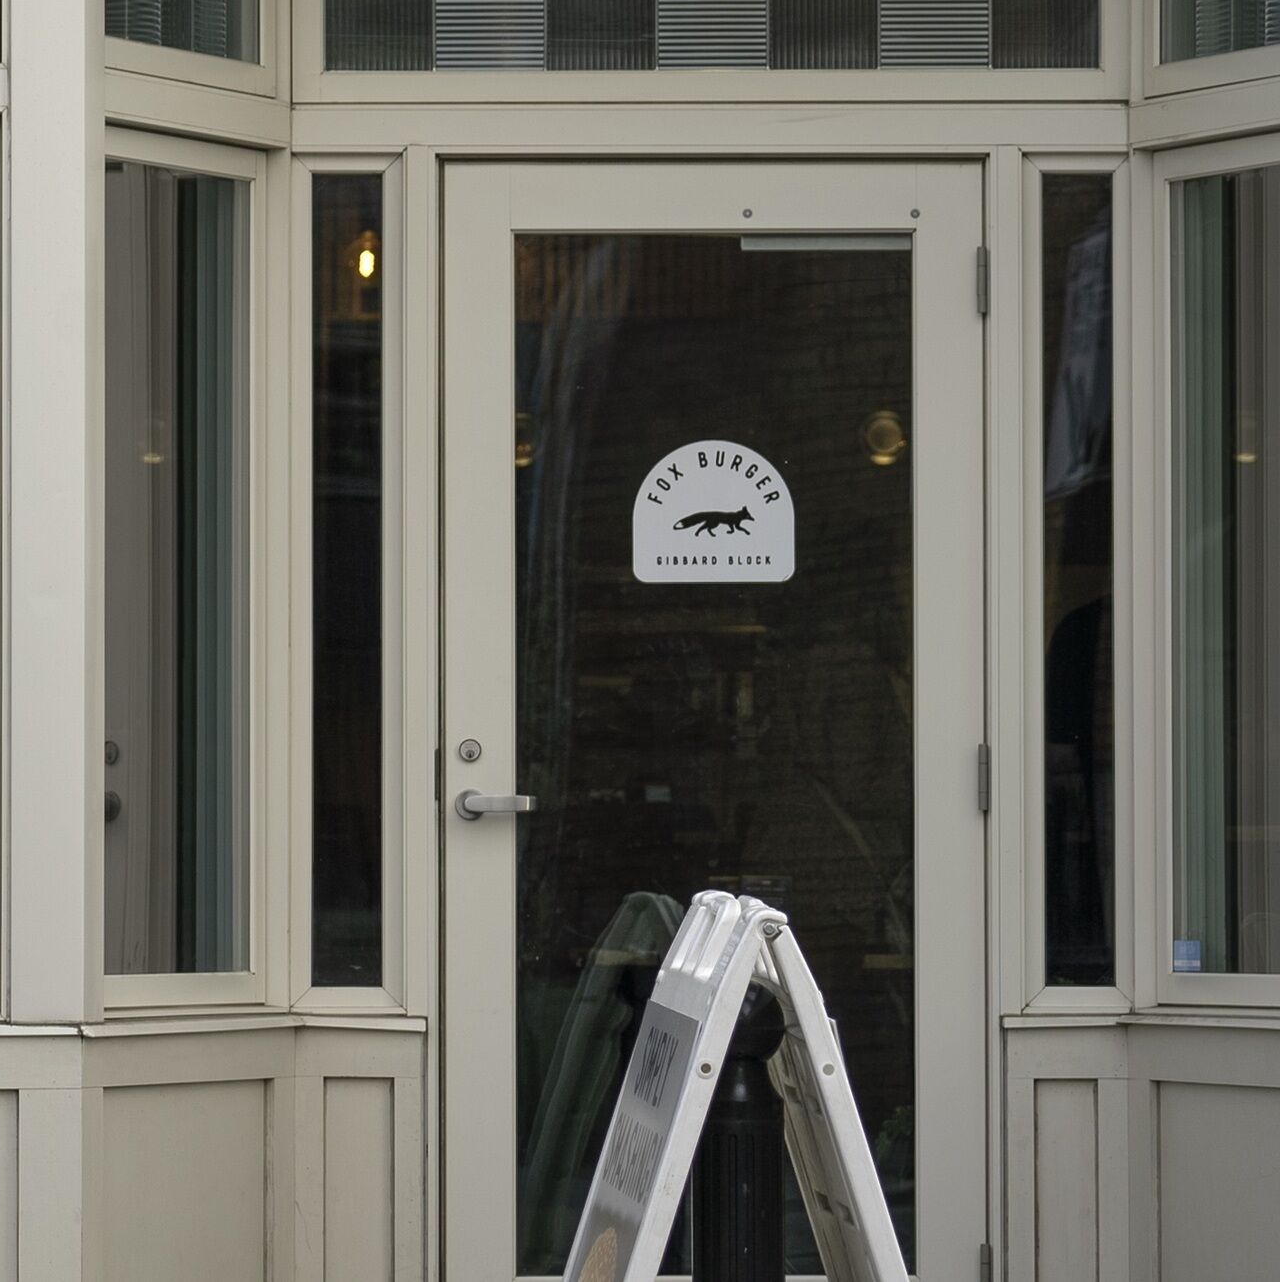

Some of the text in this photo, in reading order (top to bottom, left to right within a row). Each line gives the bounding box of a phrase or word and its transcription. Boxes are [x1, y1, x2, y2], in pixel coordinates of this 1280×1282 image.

[647, 450, 780, 505] FOX BURGER
[656, 556, 772, 566] GIBBARD BLOCK
[633, 1025, 680, 1109] SIMPLY
